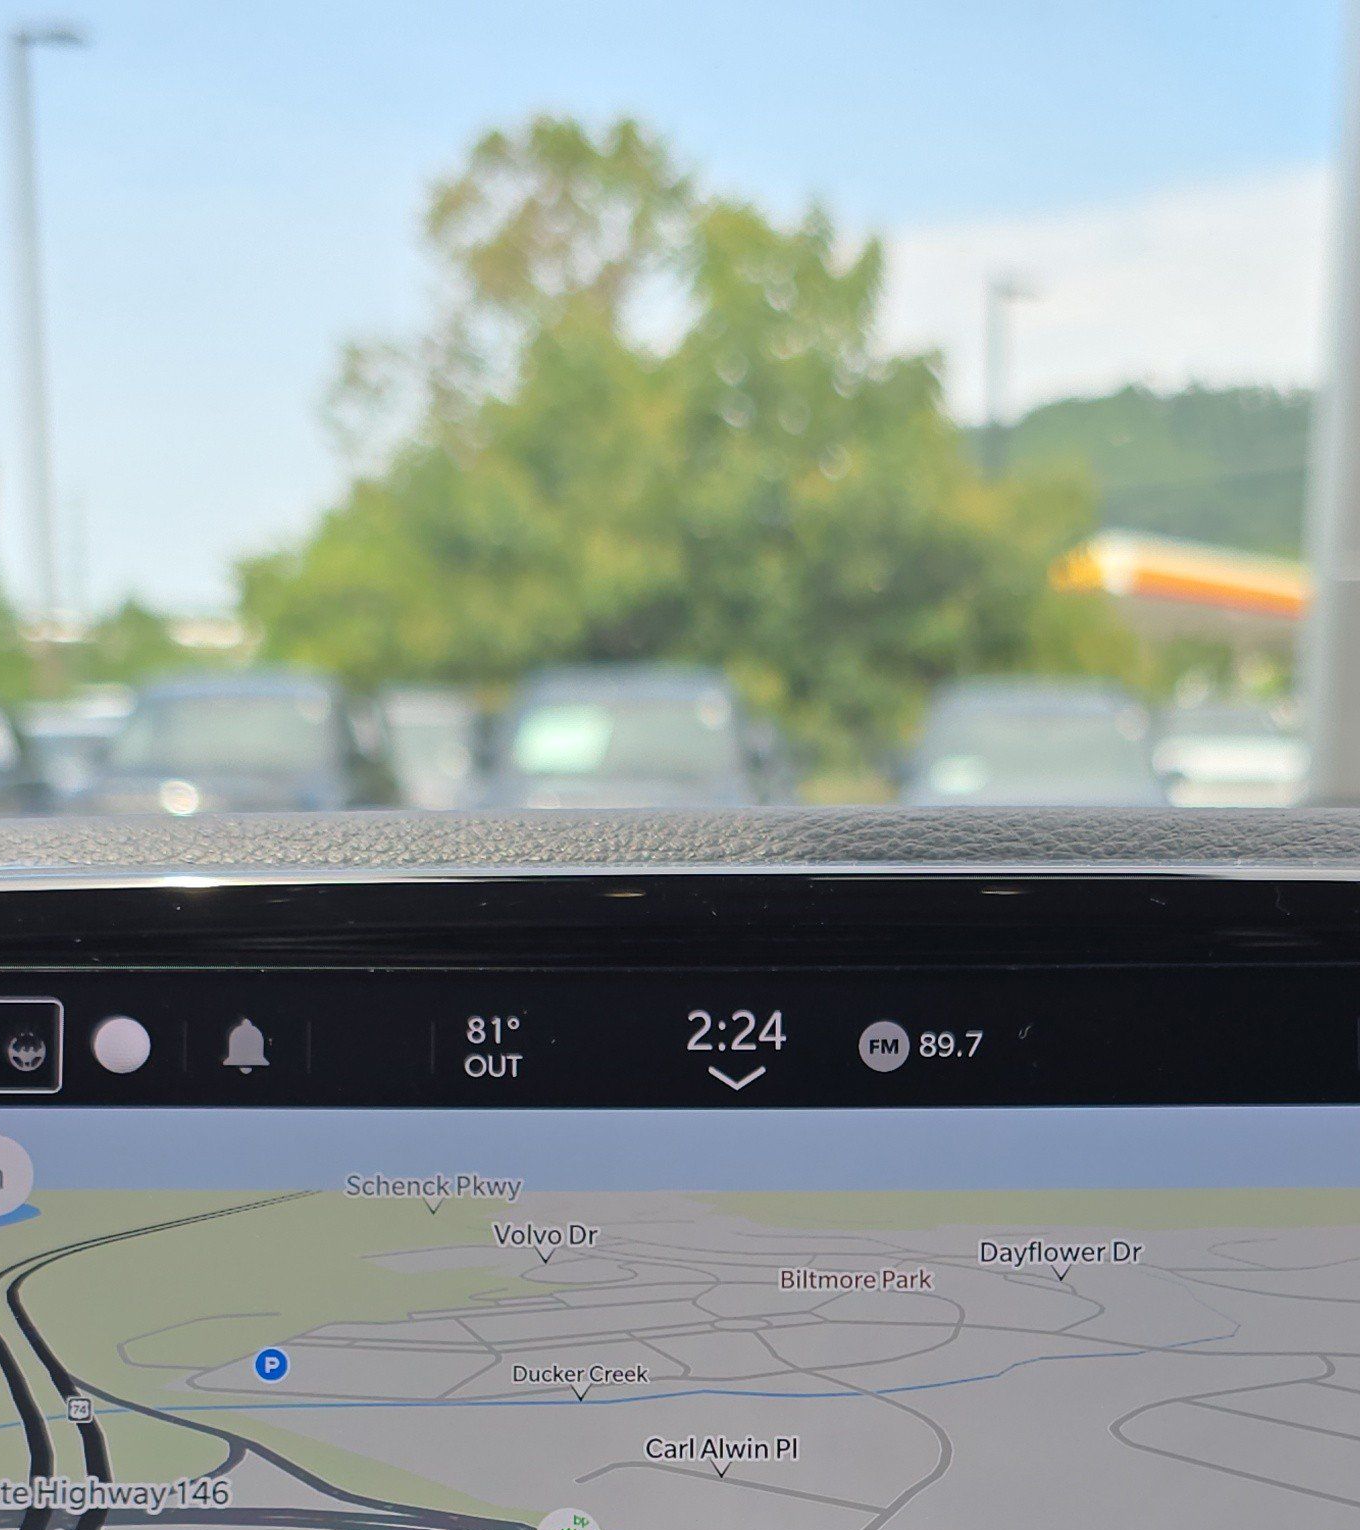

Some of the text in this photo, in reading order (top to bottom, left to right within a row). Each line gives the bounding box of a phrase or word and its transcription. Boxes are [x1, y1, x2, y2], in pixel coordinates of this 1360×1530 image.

[686, 1010, 787, 1053] 2:24
[918, 1030, 983, 1059] 89.7
[868, 1037, 900, 1056] FM
[464, 1054, 523, 1079] OUT
[345, 1173, 522, 1203] Schenck Pkwy
[494, 1222, 598, 1248] Volvo Dr
[979, 1239, 1142, 1267] Dayflower Dr
[780, 1268, 932, 1291] Biltmore Park
[512, 1364, 648, 1384] Ducker Creek
[645, 1436, 799, 1461] Carl Alwin Pl
[38, 1479, 168, 1512] Highway
[176, 1479, 230, 1505] 146
